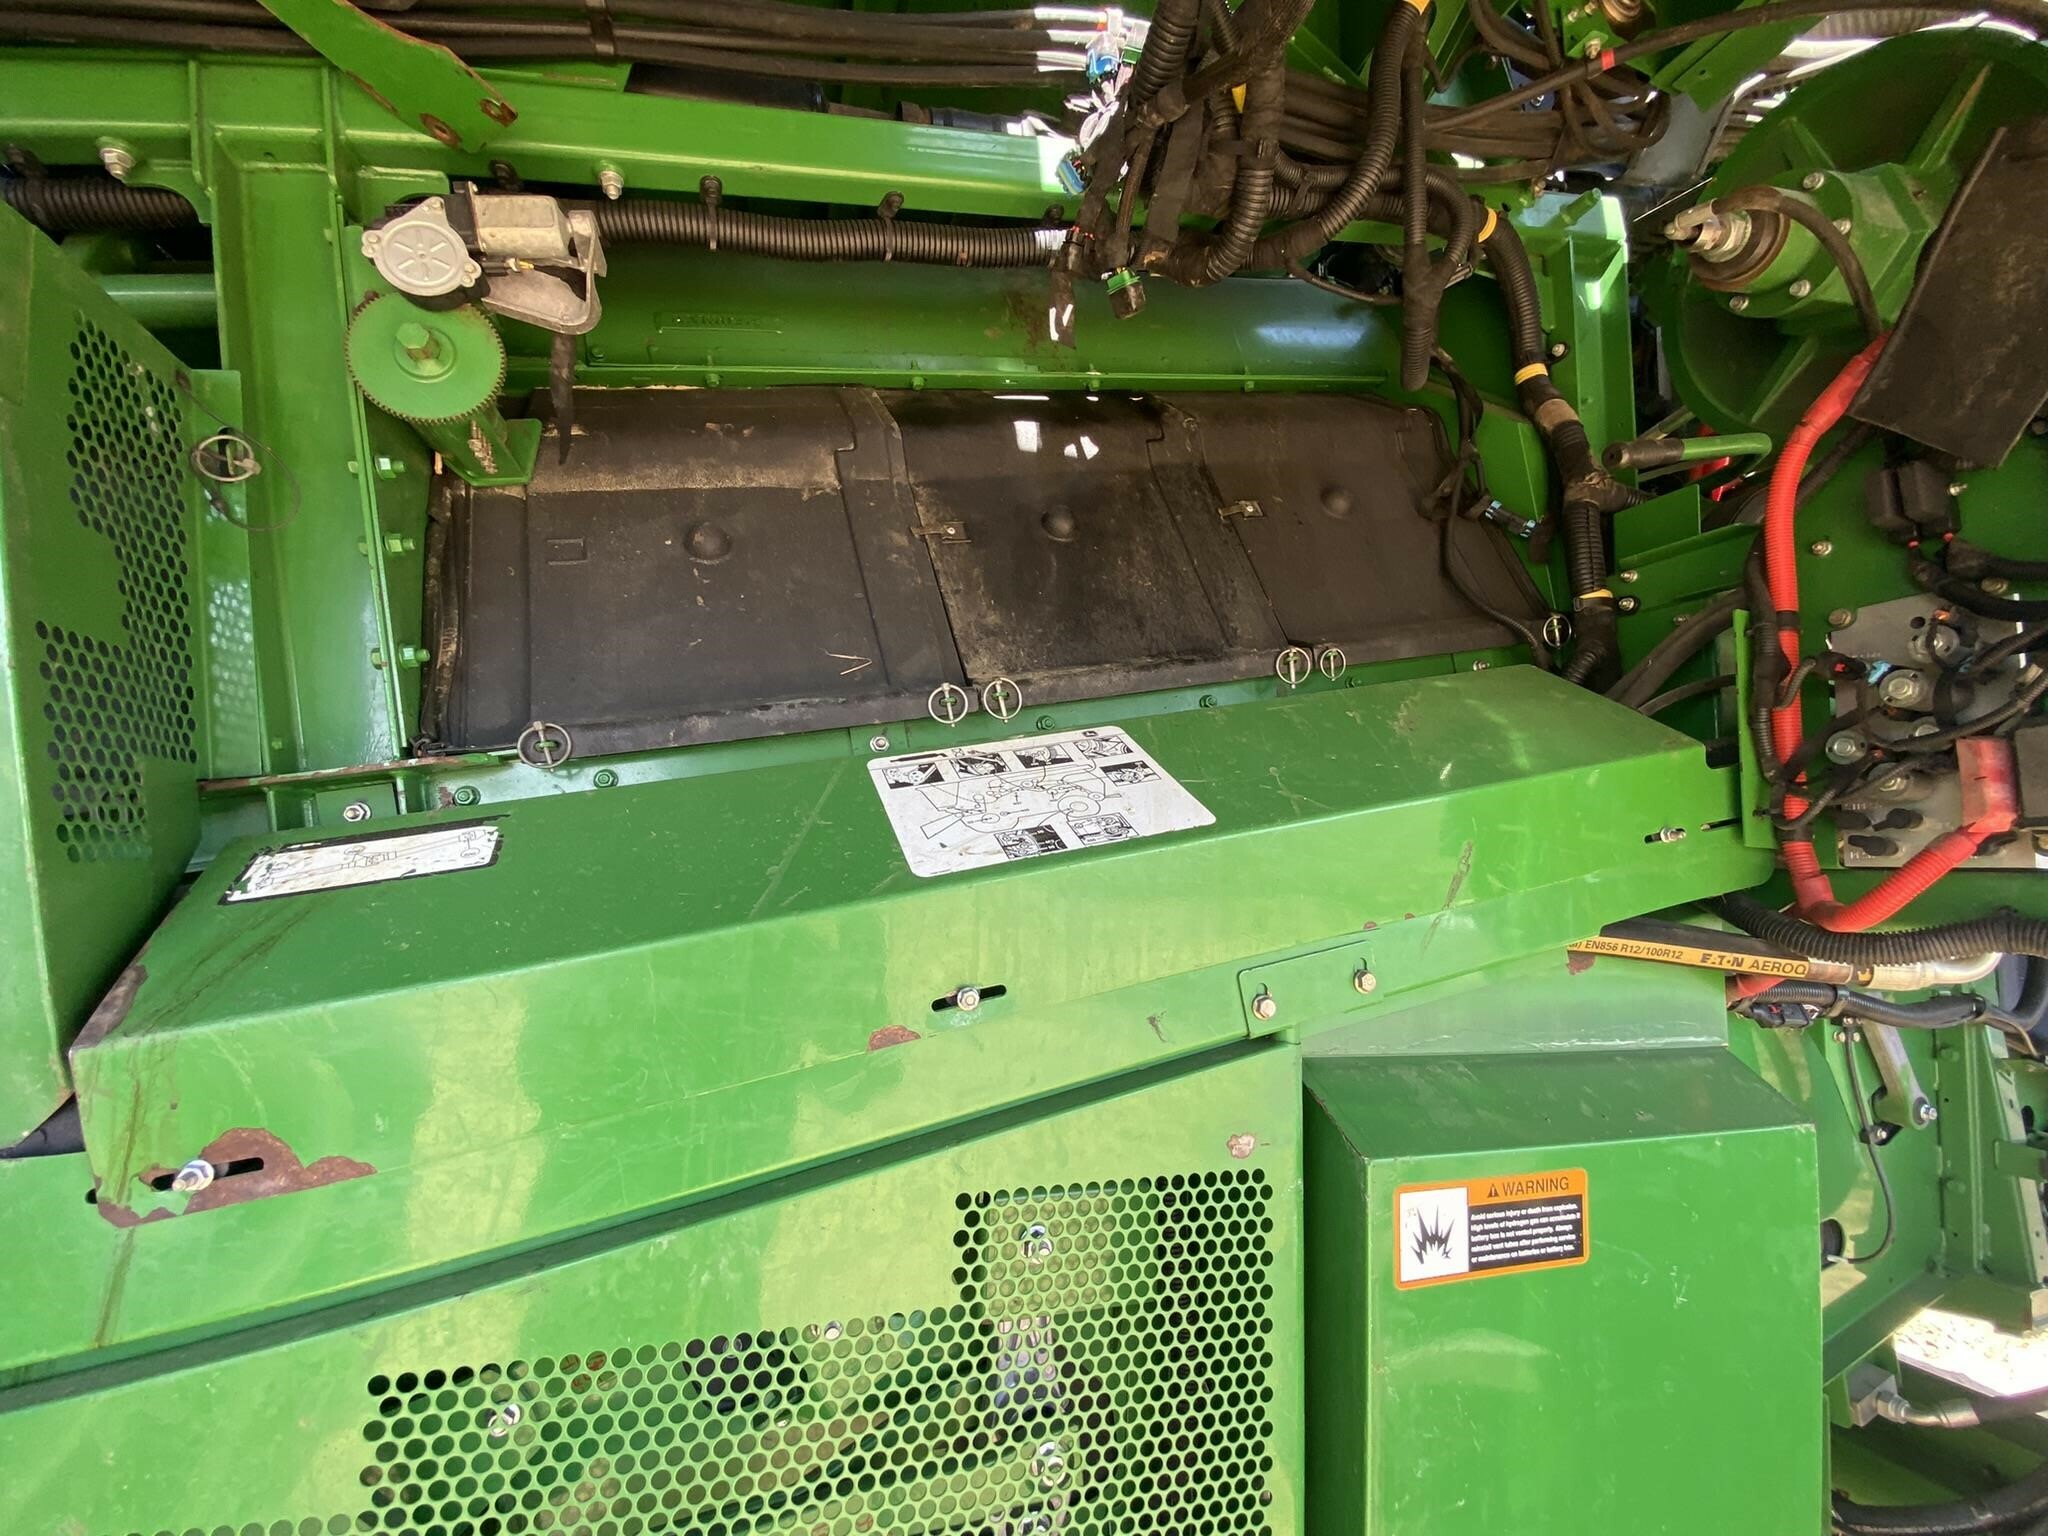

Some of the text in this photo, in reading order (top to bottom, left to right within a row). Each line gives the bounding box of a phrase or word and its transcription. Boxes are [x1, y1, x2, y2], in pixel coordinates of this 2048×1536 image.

[1585, 940, 1618, 951] EN856
[1620, 945, 1684, 960] R12/100R12
[1502, 1177, 1569, 1196] WARNING
[1506, 1210, 1520, 1218] injury
[1506, 1218, 1529, 1227] hydrogen
